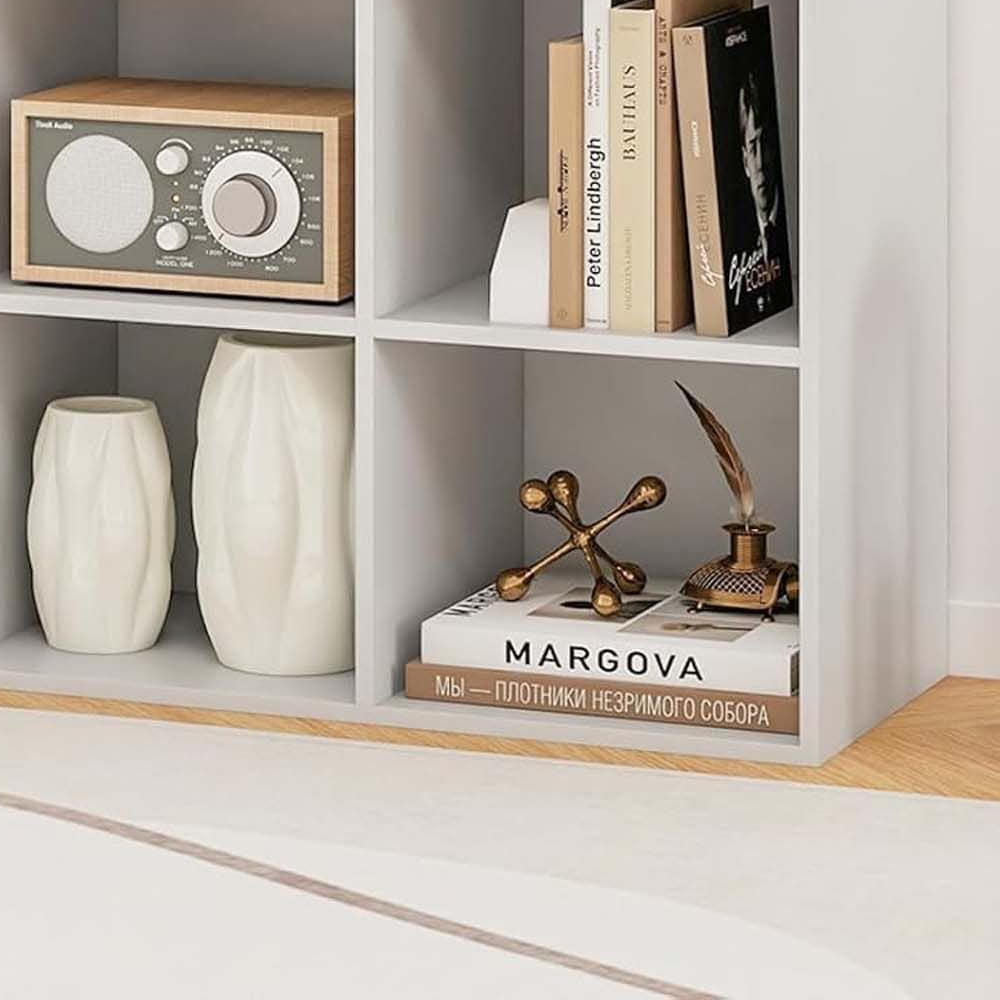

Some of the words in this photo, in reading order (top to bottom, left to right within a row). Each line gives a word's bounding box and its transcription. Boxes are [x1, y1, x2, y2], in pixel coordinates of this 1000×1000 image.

[622, 64, 637, 160] BAUHAUS
[587, 138, 605, 233] Lindbergh
[587, 239, 601, 288] Peter
[505, 640, 703, 681] MARGOVA
[435, 675, 465, 698] МЫ
[495, 681, 587, 708] ПЛОТНИКИ
[592, 691, 696, 720] НЕЗРИМОГО
[700, 701, 770, 726] СОБОРА
